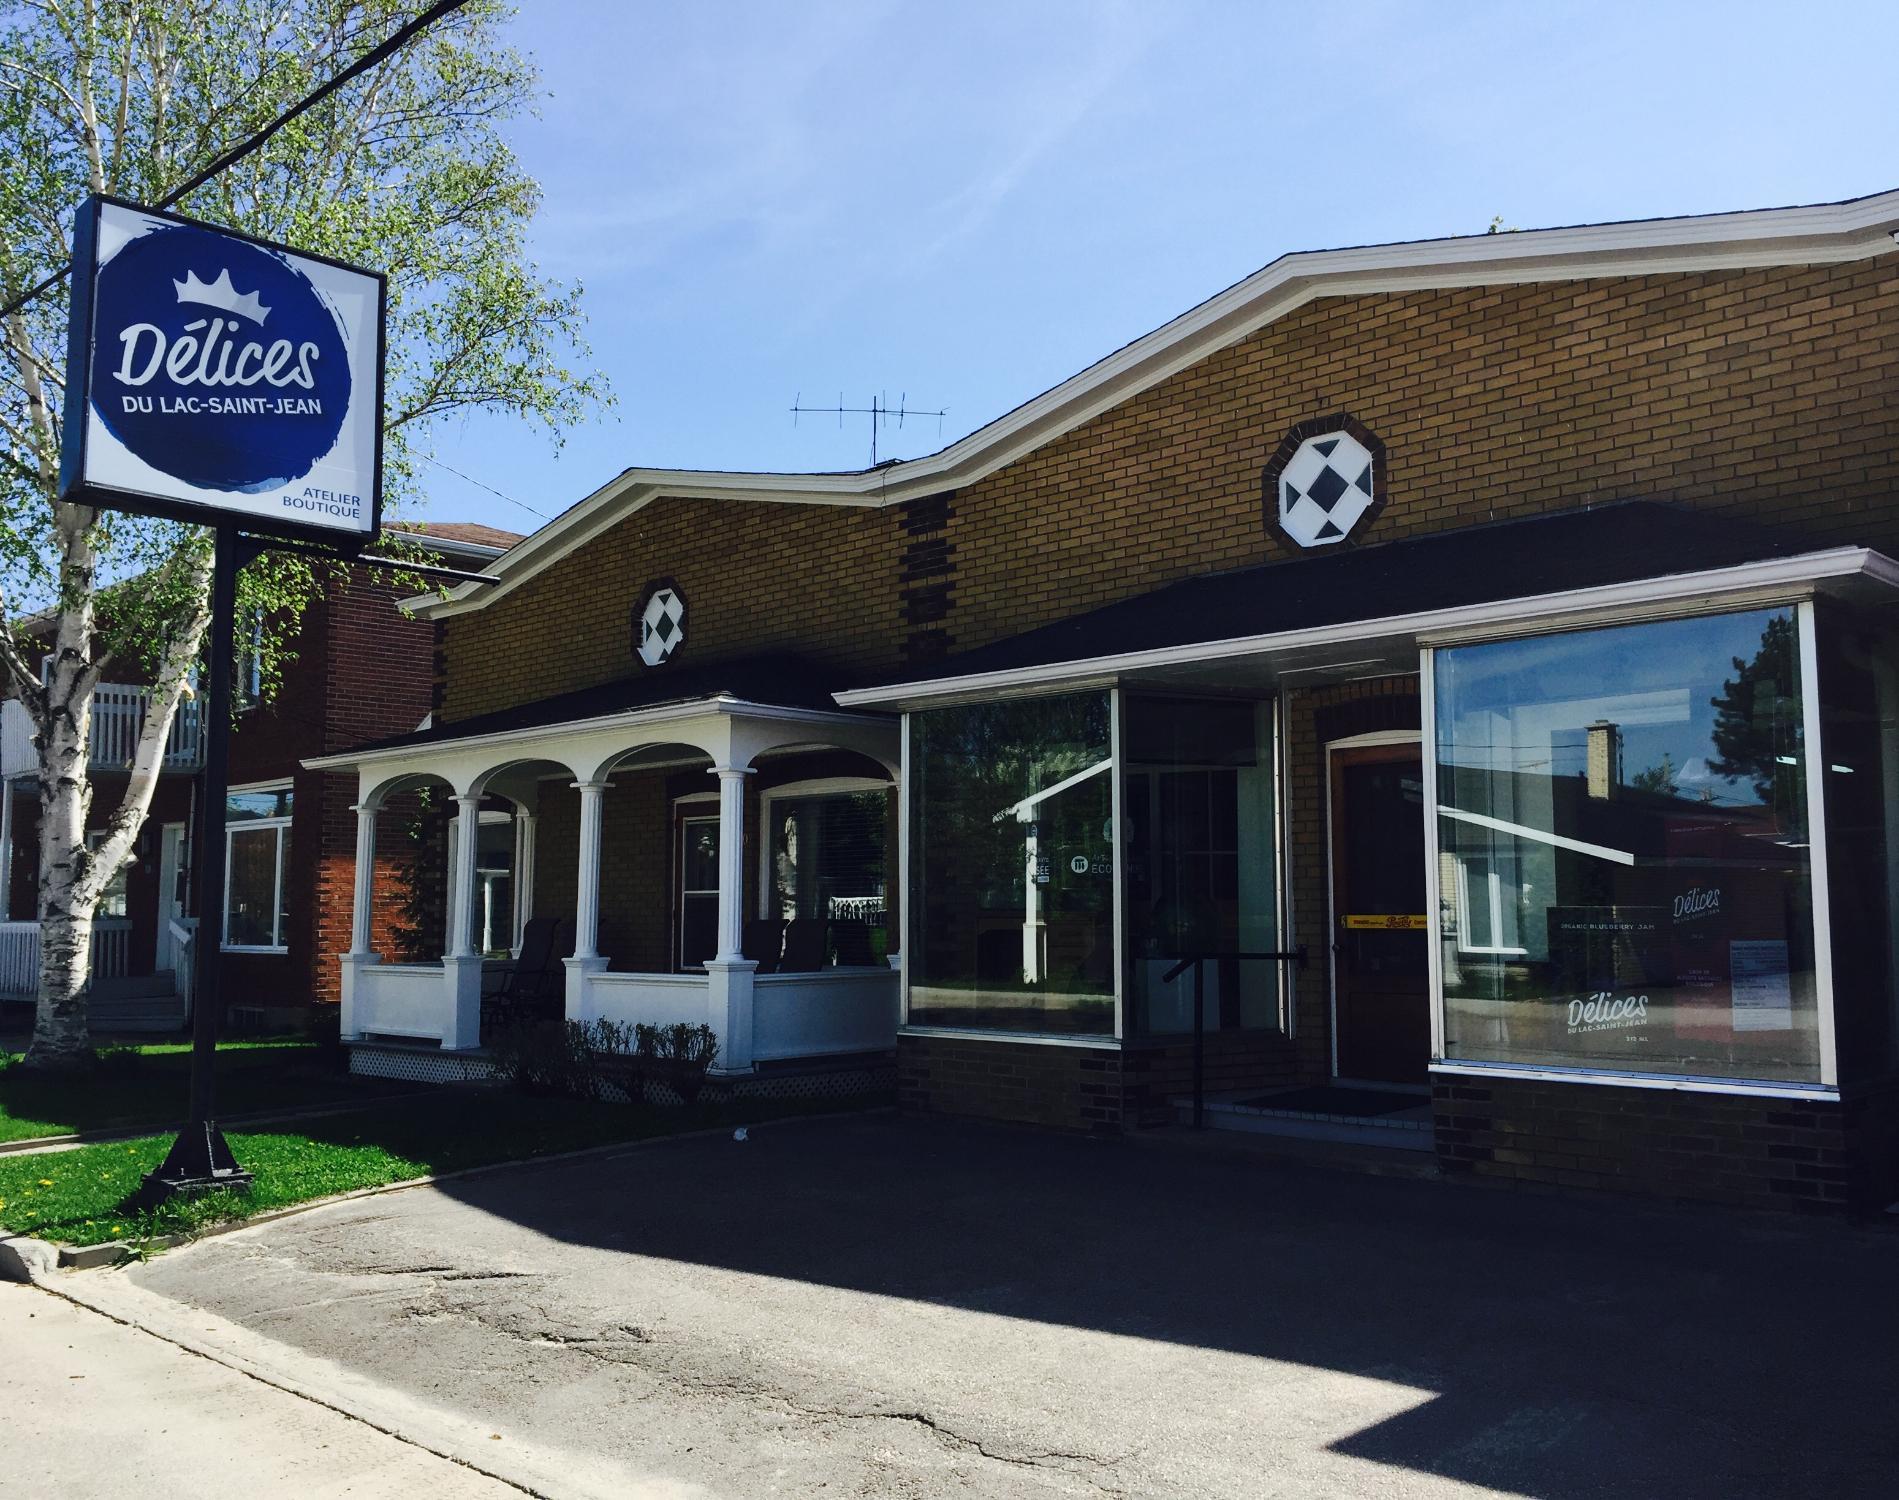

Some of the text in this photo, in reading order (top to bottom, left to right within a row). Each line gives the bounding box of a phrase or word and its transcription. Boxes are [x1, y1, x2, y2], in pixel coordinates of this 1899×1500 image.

[112, 318, 320, 389] Délices
[122, 396, 322, 415] DU LAC-SAINT-JEAN
[283, 495, 361, 520] BOUTIQUE
[303, 487, 361, 507] ATELIER
[1672, 887, 1720, 918] Délices
[1567, 992, 1648, 1027] Délices
[1578, 1018, 1648, 1033] LAC-SAINT-JEAN
